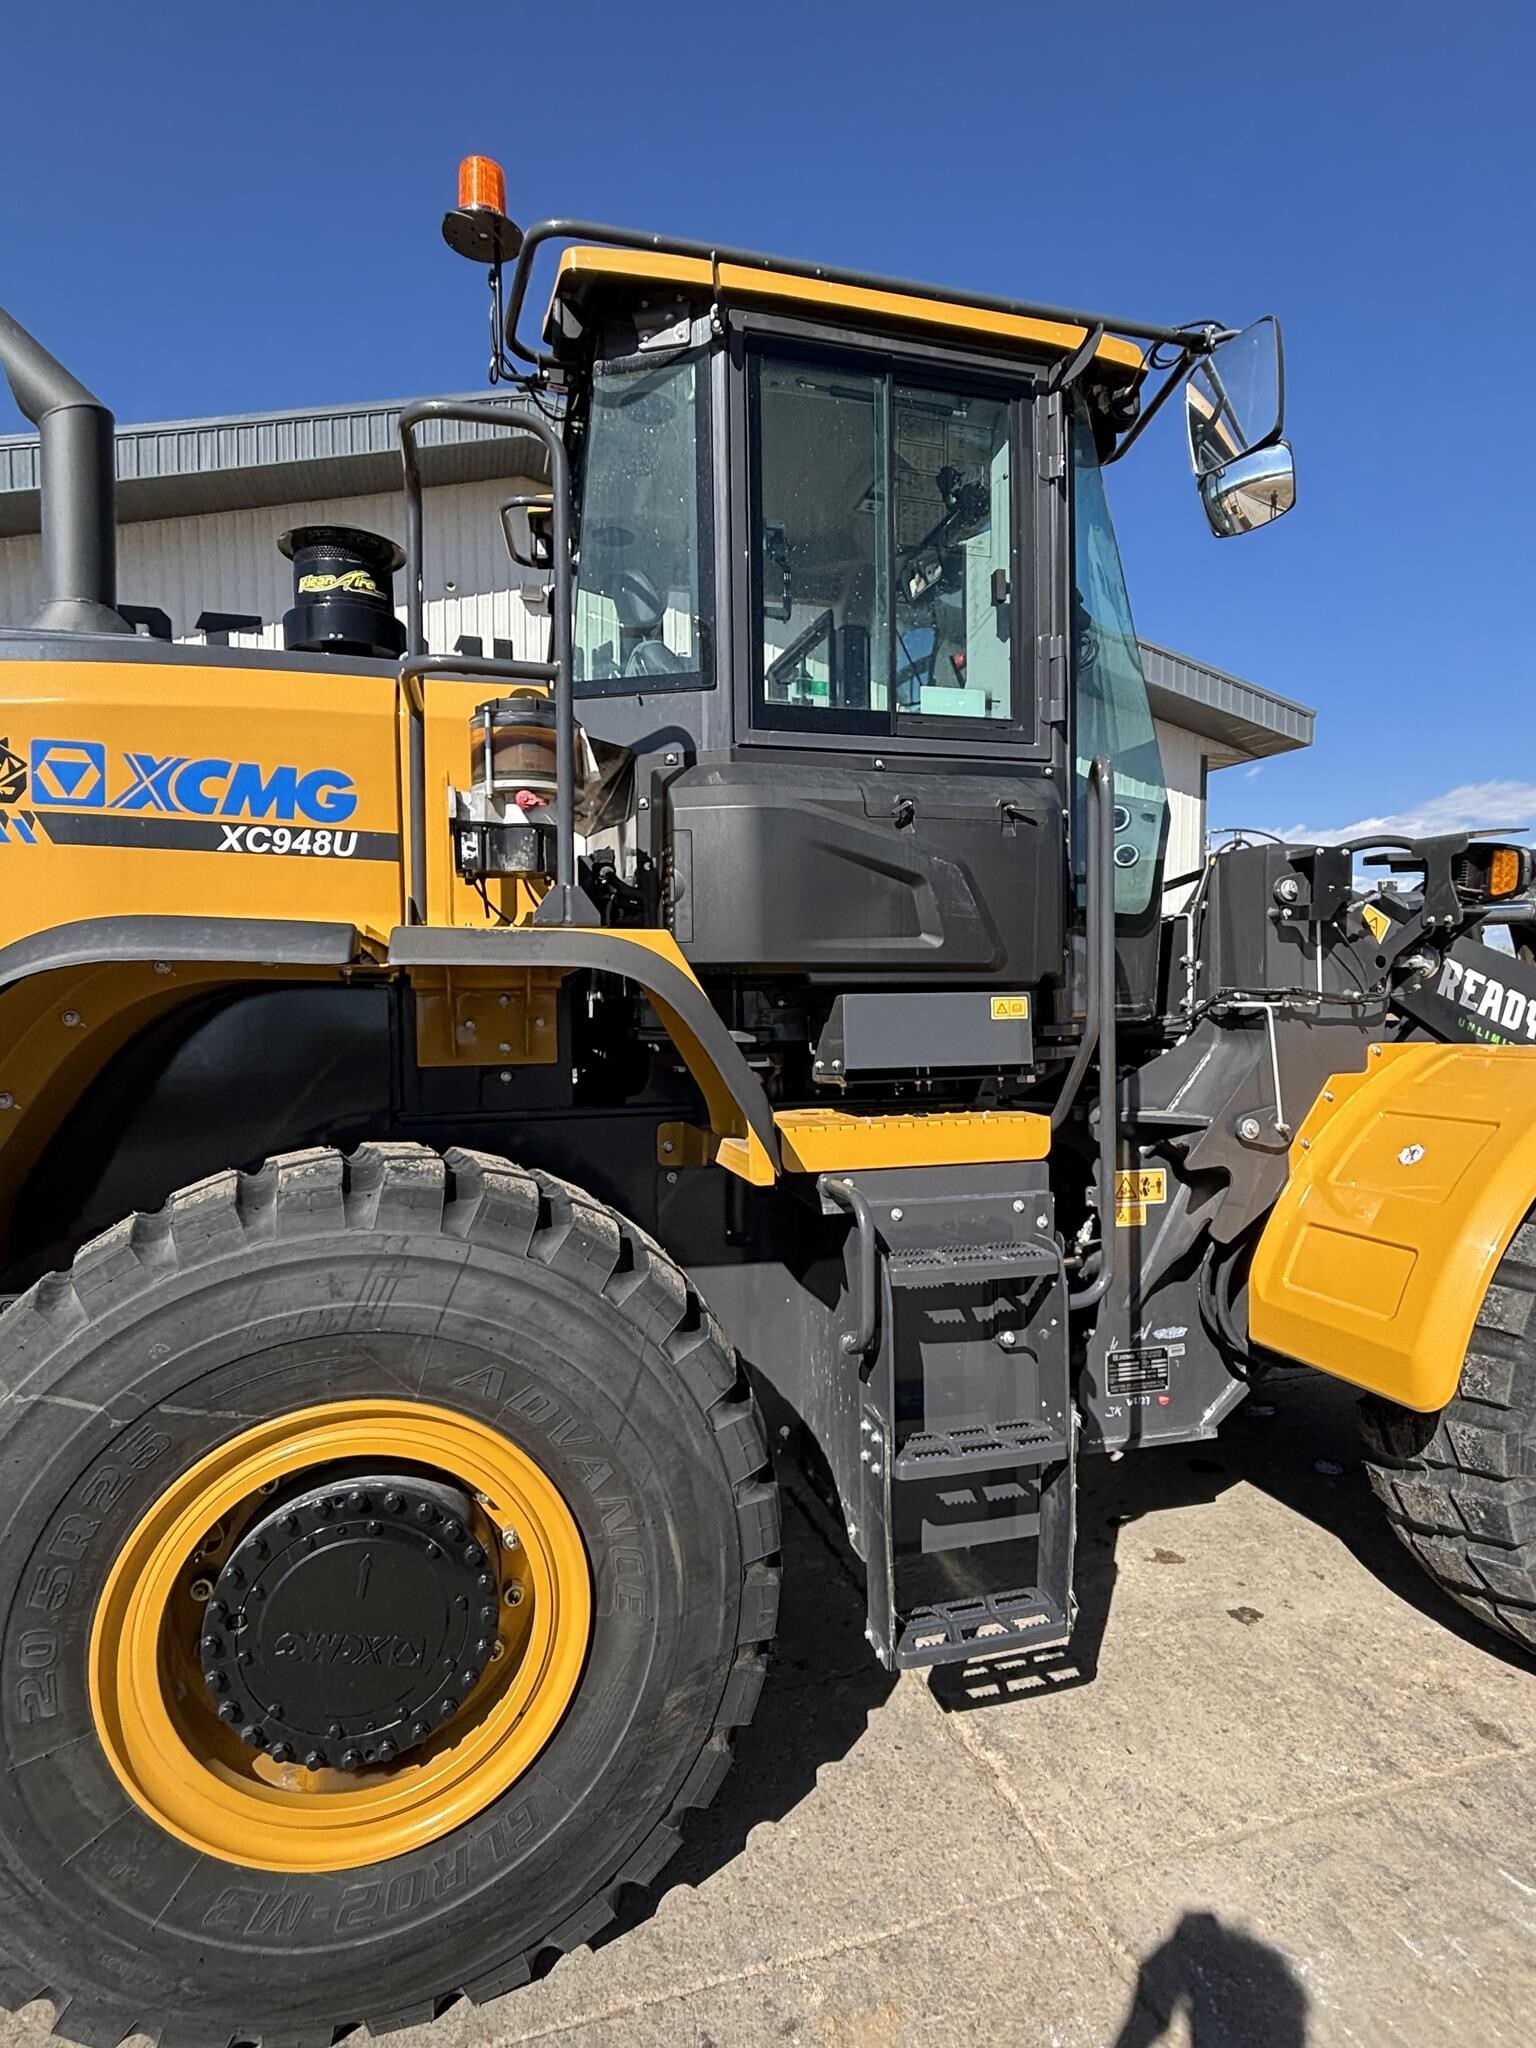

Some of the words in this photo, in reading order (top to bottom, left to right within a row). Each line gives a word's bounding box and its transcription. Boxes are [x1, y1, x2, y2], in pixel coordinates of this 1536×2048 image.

[106, 752, 358, 824] XCMG
[216, 825, 358, 857] XC948U
[453, 1364, 647, 1616] ADVANCE
[16, 1423, 172, 1724] 20.5R25
